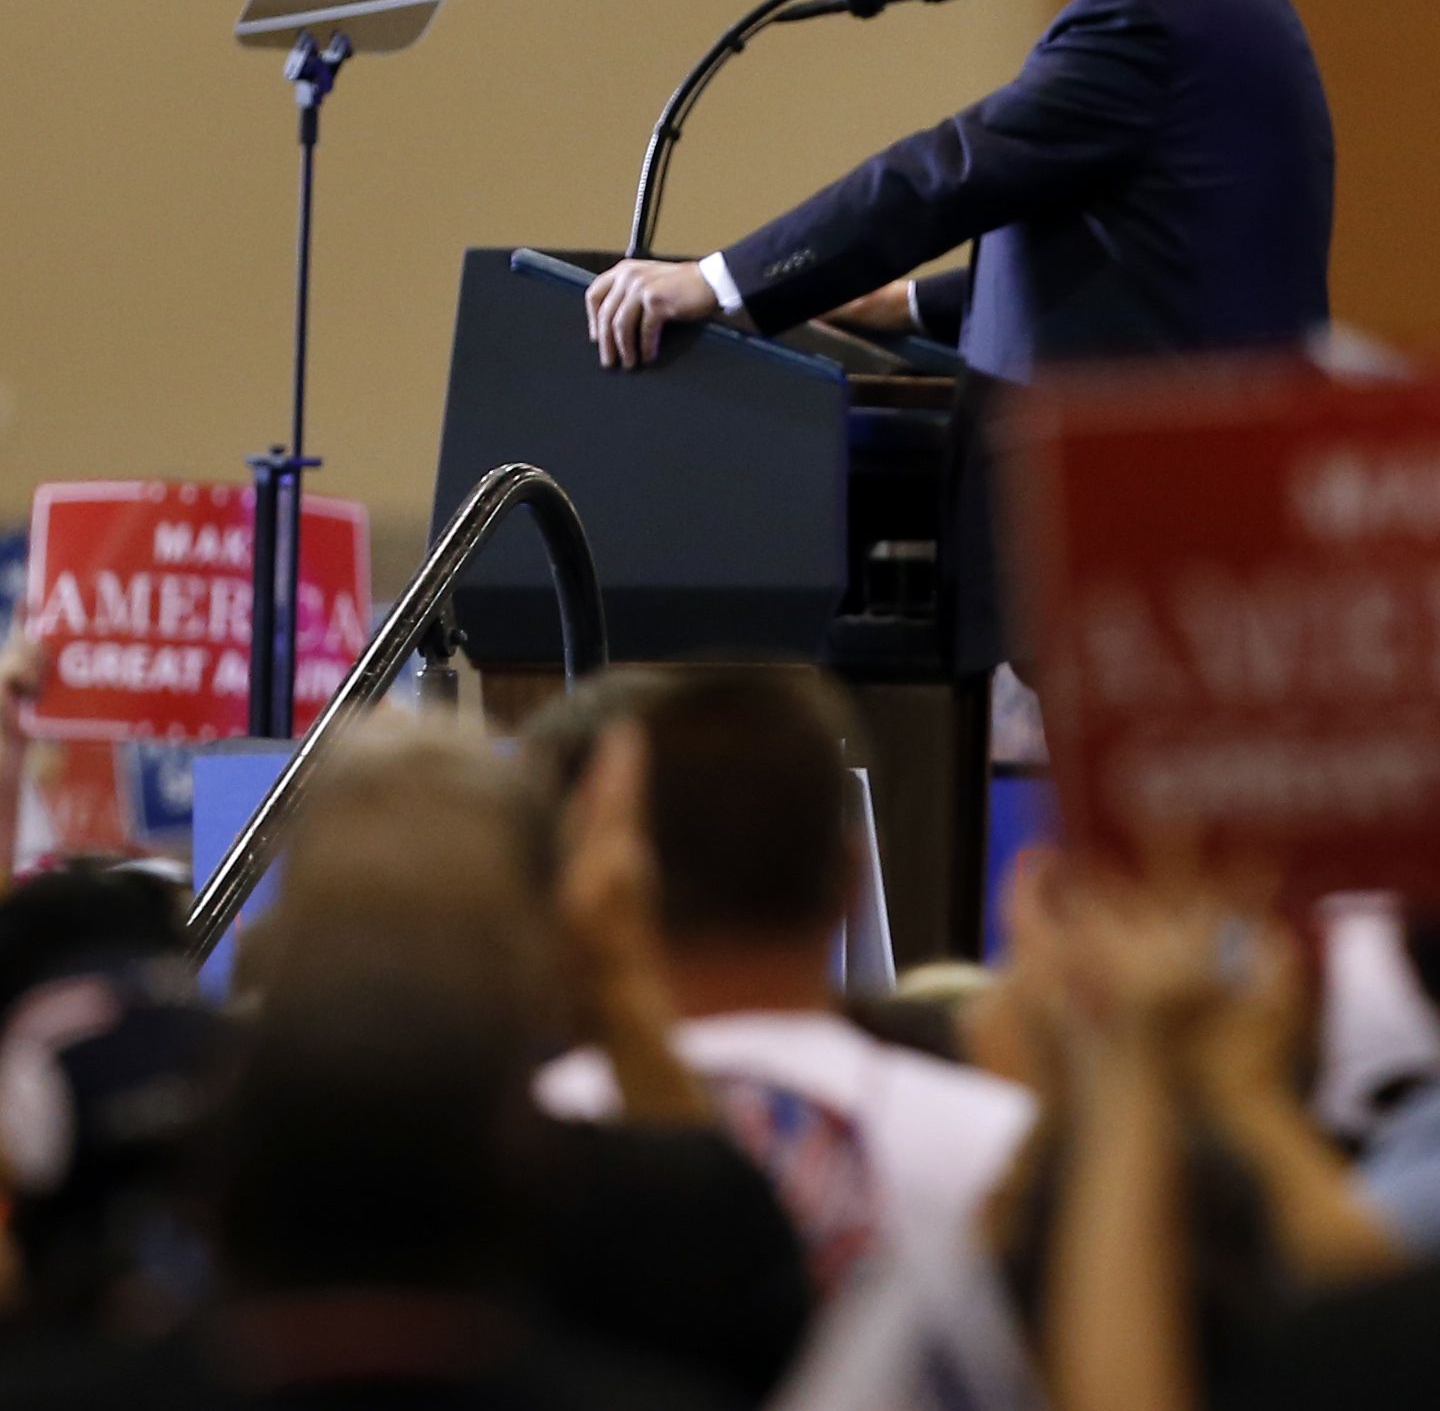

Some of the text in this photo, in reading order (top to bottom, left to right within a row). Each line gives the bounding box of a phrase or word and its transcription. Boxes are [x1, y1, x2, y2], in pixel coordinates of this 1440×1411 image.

[151, 519, 255, 565] MAK
[25, 567, 364, 655] AMERCA
[57, 641, 208, 693] GREAT
